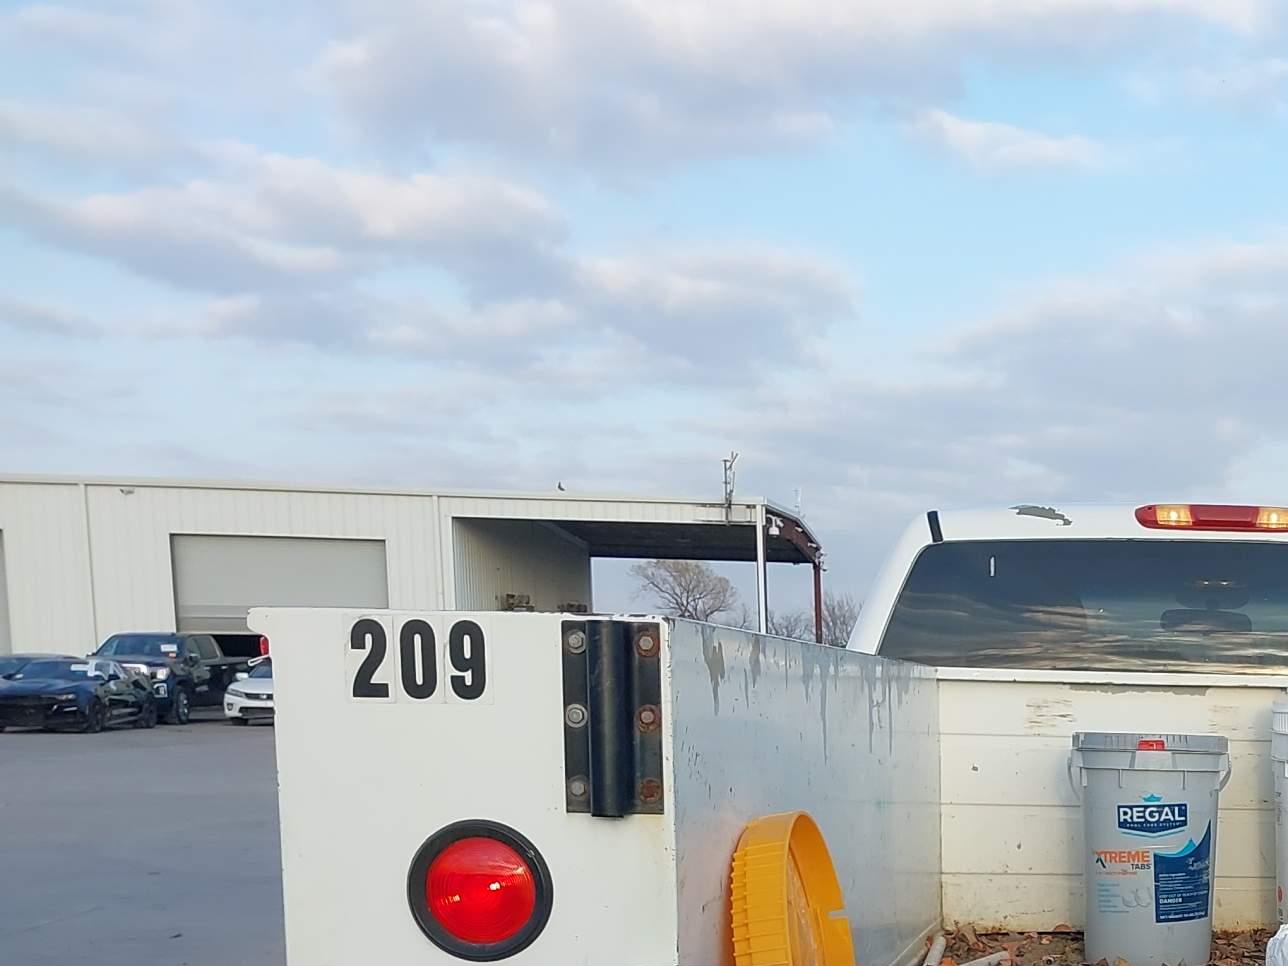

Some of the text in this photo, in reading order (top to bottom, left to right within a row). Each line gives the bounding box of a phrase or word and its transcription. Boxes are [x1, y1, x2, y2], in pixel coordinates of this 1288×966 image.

[350, 618, 487, 700] 209
[1119, 807, 1186, 822] REGAL
[1094, 850, 1150, 869] XTREME
